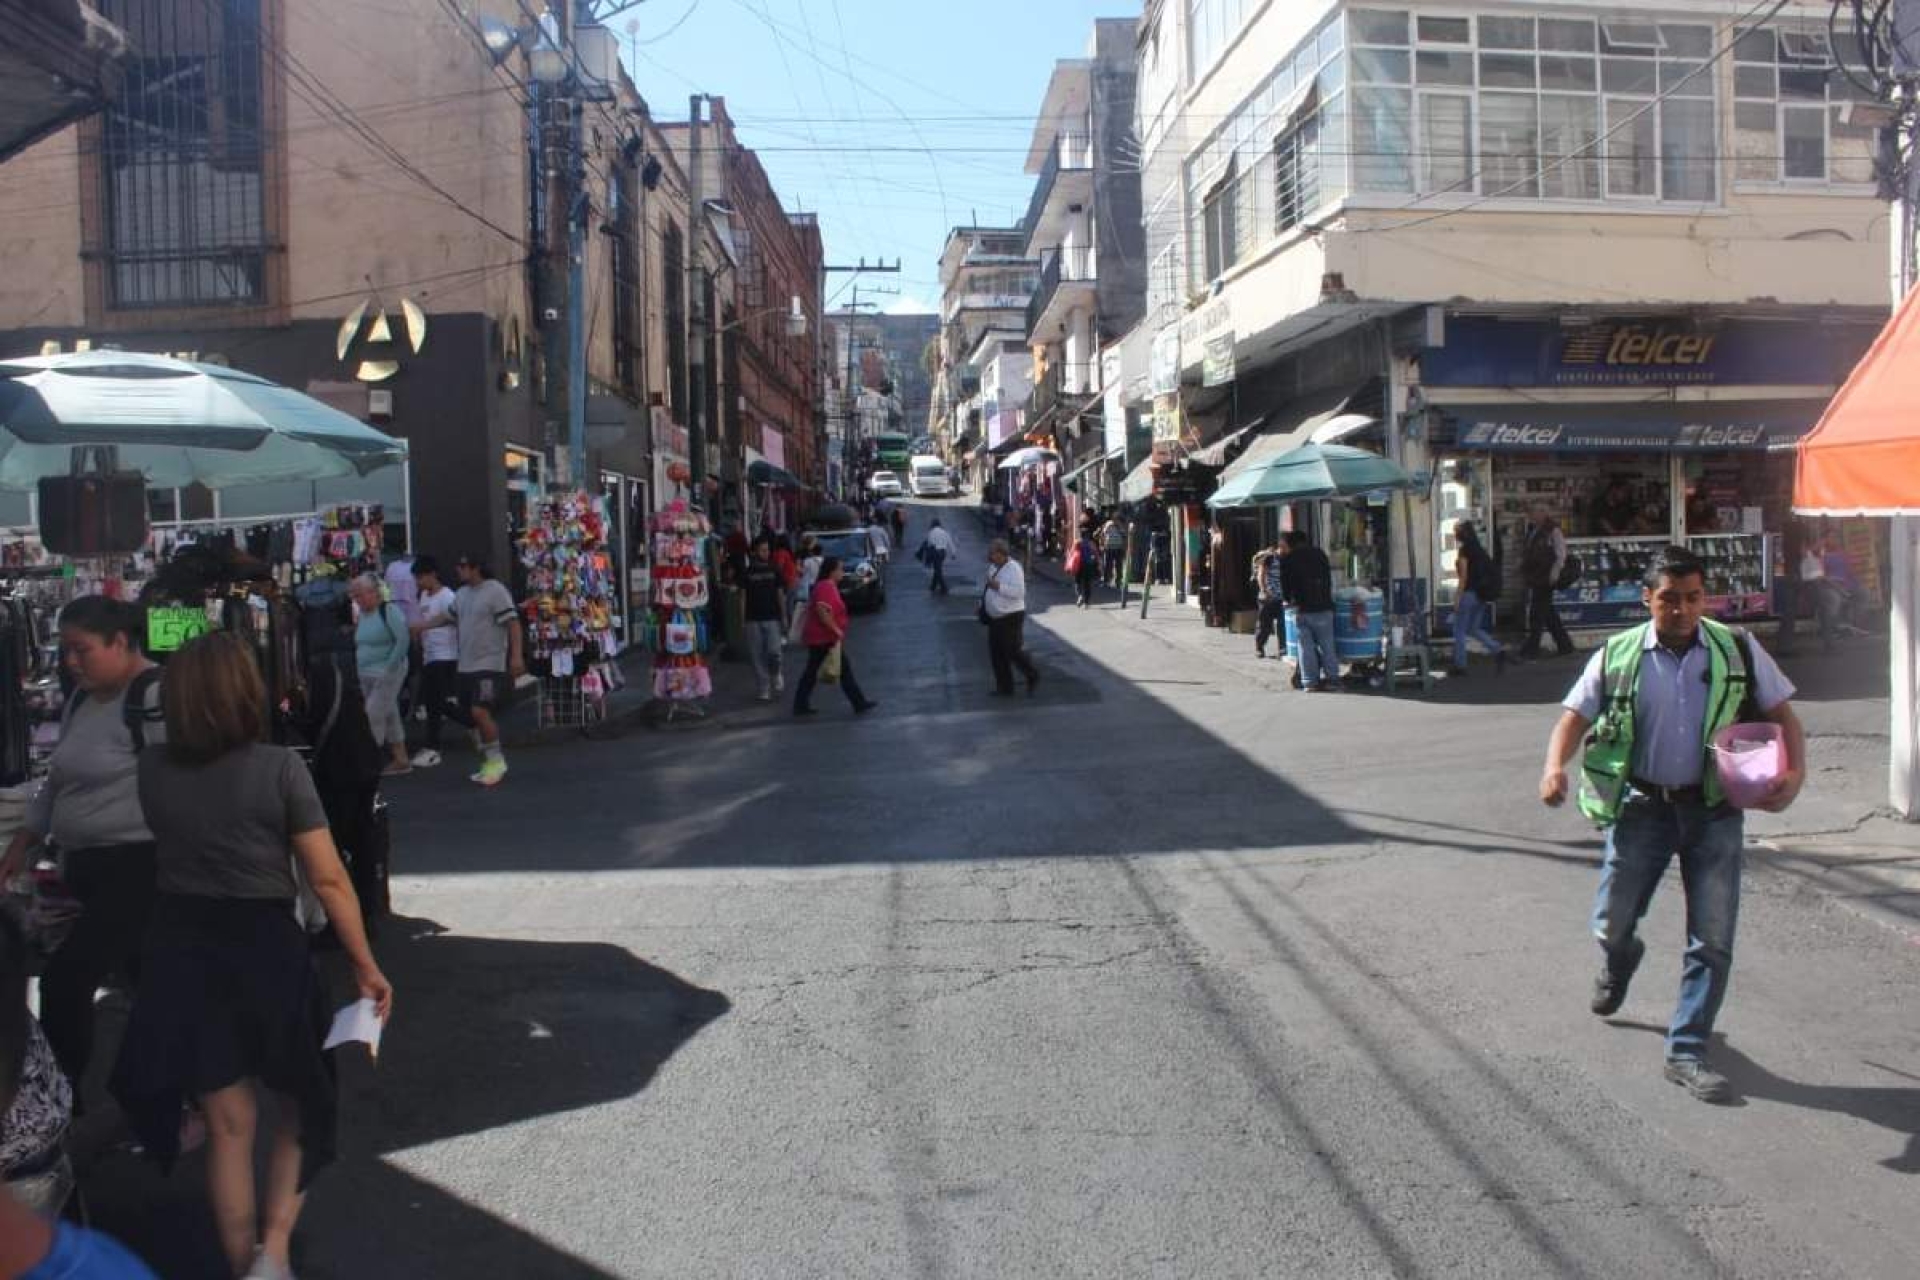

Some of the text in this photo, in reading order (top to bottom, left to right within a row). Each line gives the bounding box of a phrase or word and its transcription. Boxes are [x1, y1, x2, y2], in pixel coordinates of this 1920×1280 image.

[1606, 327, 1715, 365] telcel
[1490, 422, 1563, 445] telcel
[1699, 423, 1766, 446] telcel
